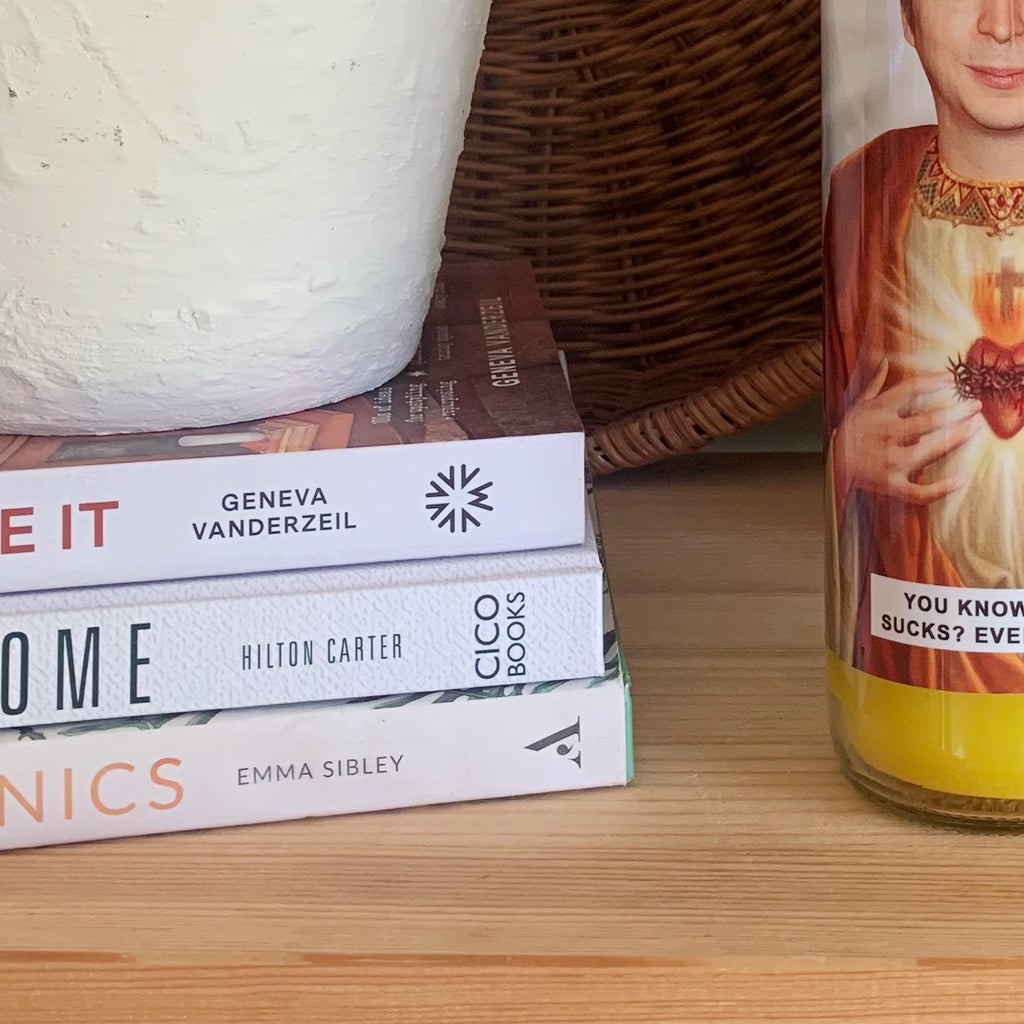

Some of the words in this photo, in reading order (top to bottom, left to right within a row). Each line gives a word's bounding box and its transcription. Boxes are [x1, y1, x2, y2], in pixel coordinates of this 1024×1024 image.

[479, 297, 511, 347] VANDERZEIL
[487, 347, 520, 387] GENEVA
[221, 487, 328, 512] GENEVA
[61, 500, 119, 550] IT
[192, 512, 357, 540] VANDERZEIL
[903, 592, 948, 615] YOU
[474, 593, 501, 680] CICO
[507, 591, 526, 677] BOOKS
[881, 613, 965, 642] SUCKS?
[1, 622, 151, 716] OME
[242, 639, 314, 671] HILTON
[327, 633, 403, 664] CARTER
[237, 762, 314, 786] EMMA
[322, 754, 404, 778] SIBLEY
[0, 757, 185, 827] NICS
